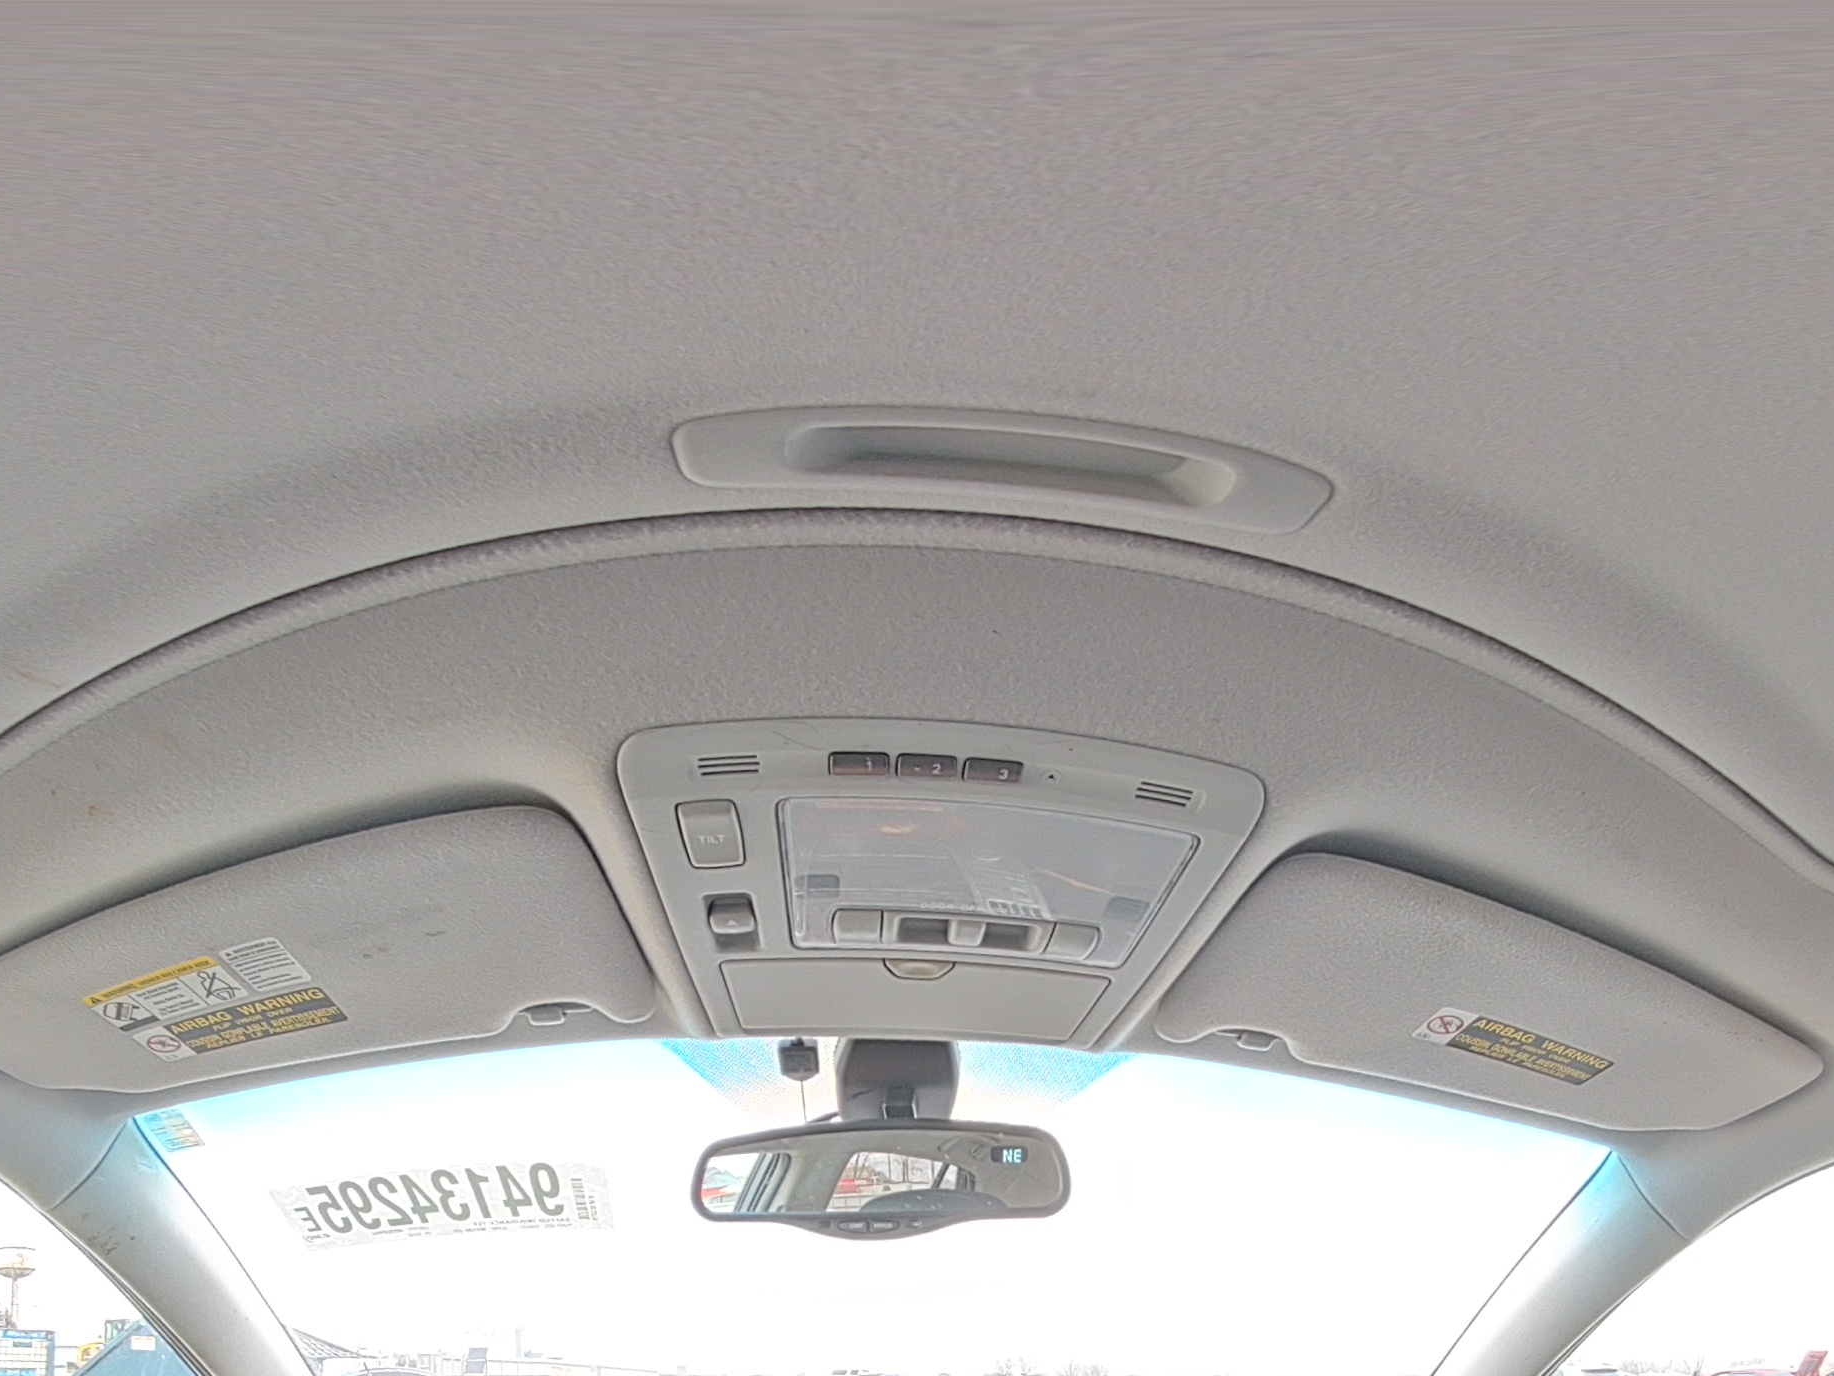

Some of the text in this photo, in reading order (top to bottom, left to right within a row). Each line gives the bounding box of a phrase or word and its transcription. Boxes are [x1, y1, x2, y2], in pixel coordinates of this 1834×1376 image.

[931, 764, 942, 775] 2
[998, 769, 1009, 780] 3
[698, 834, 726, 844] TILT
[170, 988, 326, 1035] AIRBAG WARNING
[267, 1007, 293, 1018] OVER
[1454, 1033, 1491, 1050] COUSSIN
[1473, 1019, 1609, 1070] AIRBAG WARNING
[1003, 1149, 1022, 1164] NE
